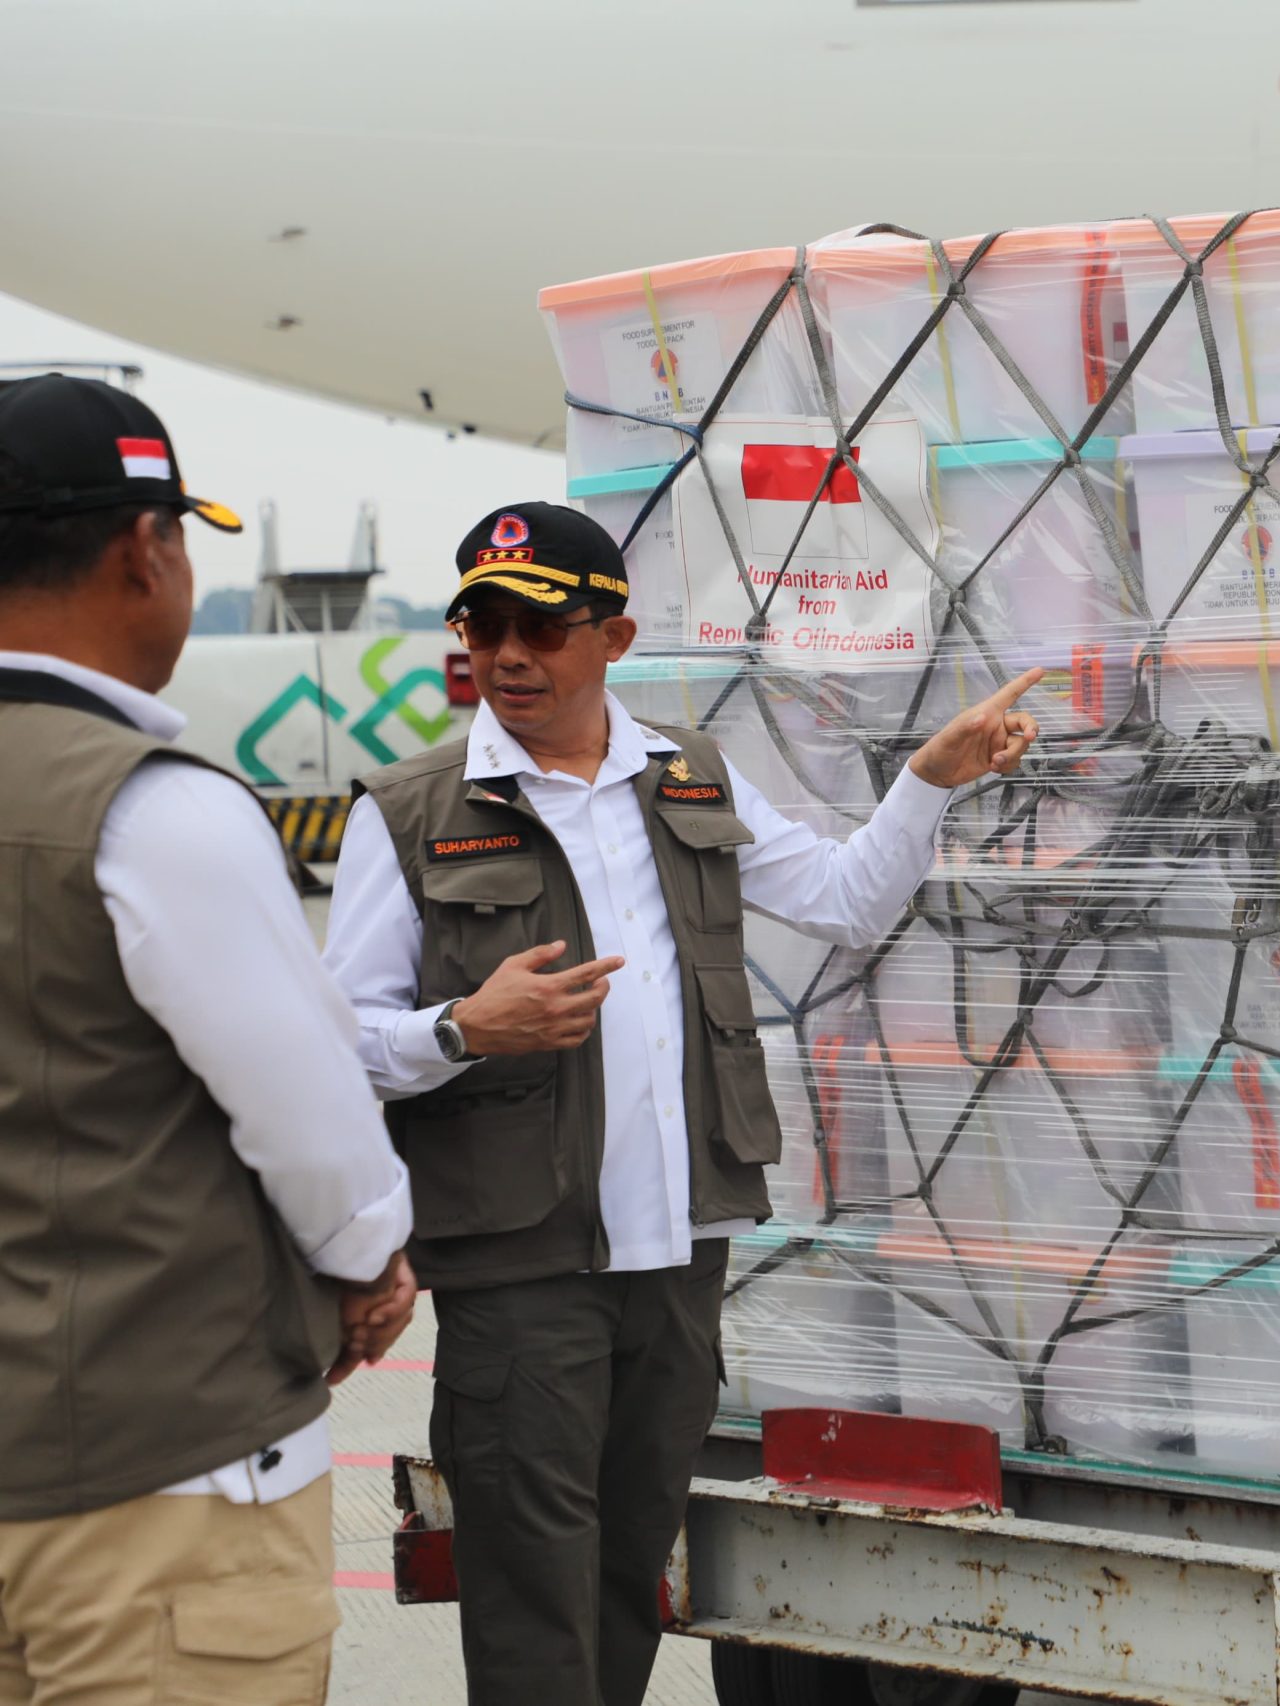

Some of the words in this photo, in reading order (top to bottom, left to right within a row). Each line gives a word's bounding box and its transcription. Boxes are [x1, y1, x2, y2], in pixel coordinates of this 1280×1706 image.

[622, 330, 641, 341] FOOD
[655, 387, 684, 401] BNB
[589, 572, 616, 592] KEPALA
[855, 569, 889, 591] Aid
[1220, 581, 1253, 592] BANTUAN
[798, 595, 836, 616] from
[699, 621, 785, 647] Repulic
[661, 786, 720, 800] INDONESIA
[434, 834, 521, 855] SUHARYANTO
